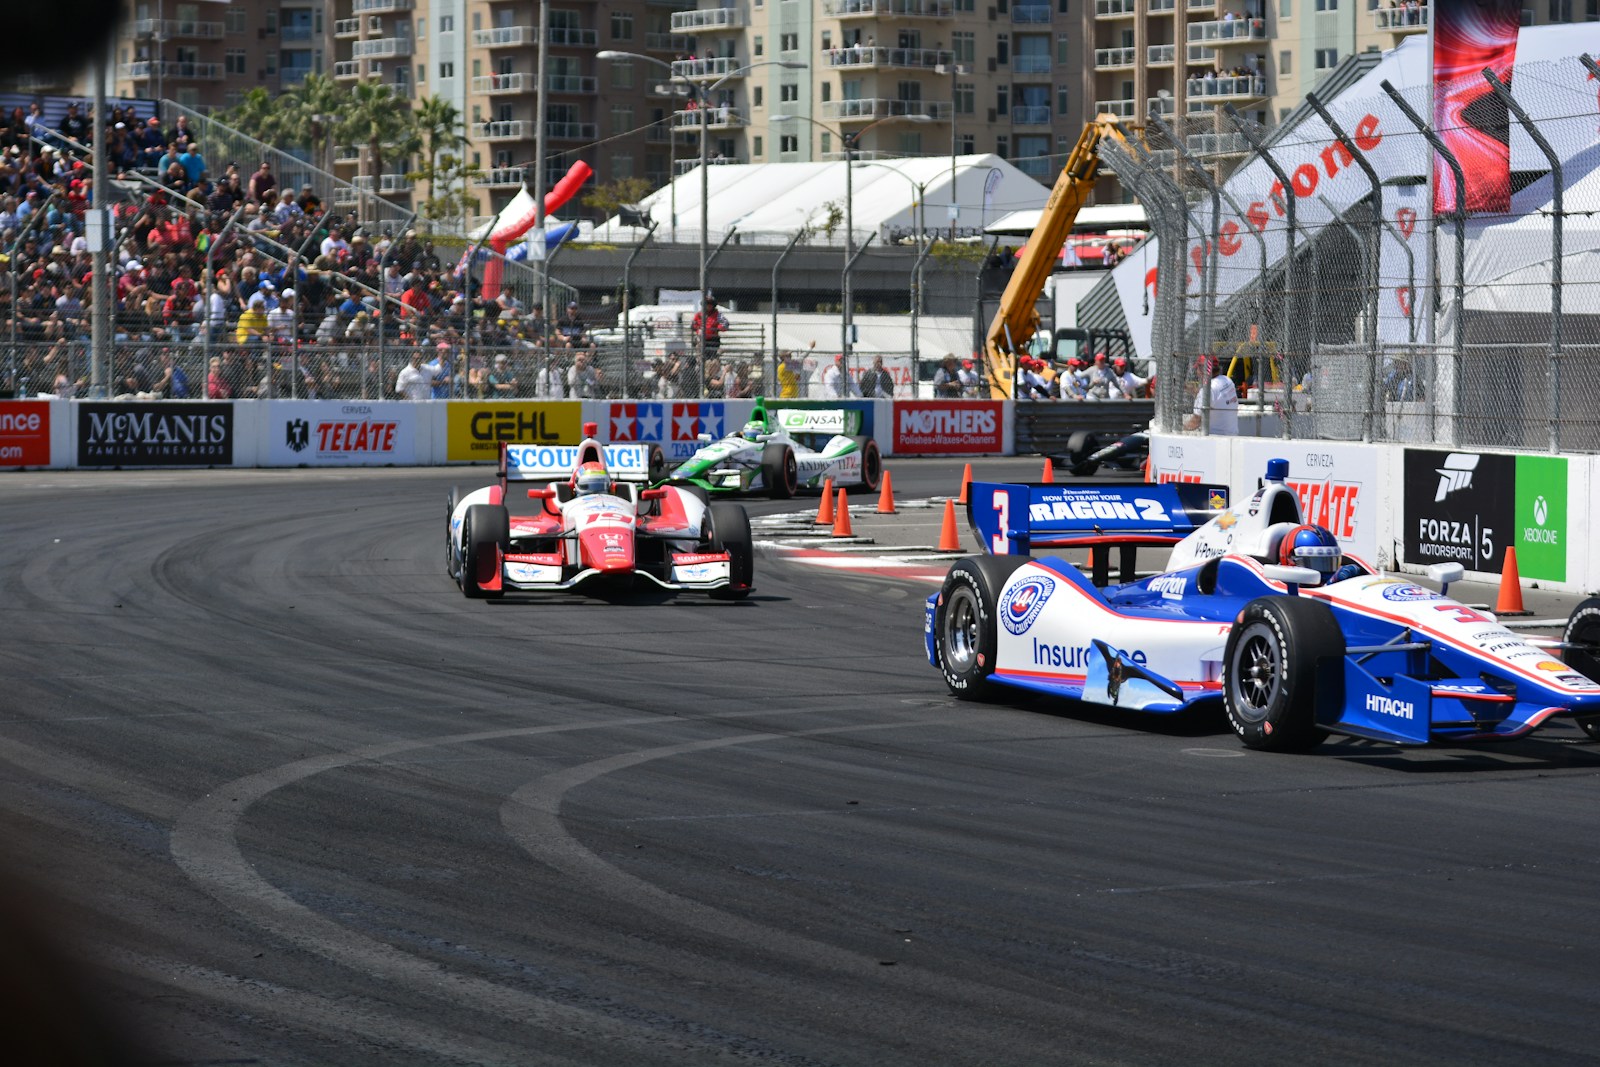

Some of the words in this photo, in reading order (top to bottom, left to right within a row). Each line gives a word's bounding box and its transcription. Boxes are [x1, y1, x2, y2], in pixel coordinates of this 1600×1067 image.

[341, 406, 372, 414] CERVEZA
[901, 409, 996, 434] MOTHERS
[87, 412, 226, 443] McMANIS
[316, 420, 397, 451] TECATE
[471, 411, 560, 441] GEHL
[0, 446, 22, 459] om
[87, 446, 137, 456] FAMILY
[147, 446, 224, 456] VINEYARDS
[507, 448, 641, 468] SCOUNG!
[1306, 453, 1335, 468] CERVEZA
[992, 489, 1010, 555] 3
[1029, 501, 1140, 522] RAGON
[1134, 498, 1171, 522] 2
[1419, 518, 1472, 545] FORZA
[1481, 527, 1494, 560] 5
[1524, 527, 1543, 543] XBOX
[1542, 529, 1558, 545] ONE
[1195, 542, 1228, 558] V-Power
[1419, 543, 1472, 560] MOTORSPORT
[1011, 589, 1037, 608] AAA
[1147, 573, 1188, 600] verizon
[1015, 600, 1045, 635] CALIFORNIA
[1033, 637, 1148, 669] Insure
[1365, 693, 1414, 720] HITACHI
